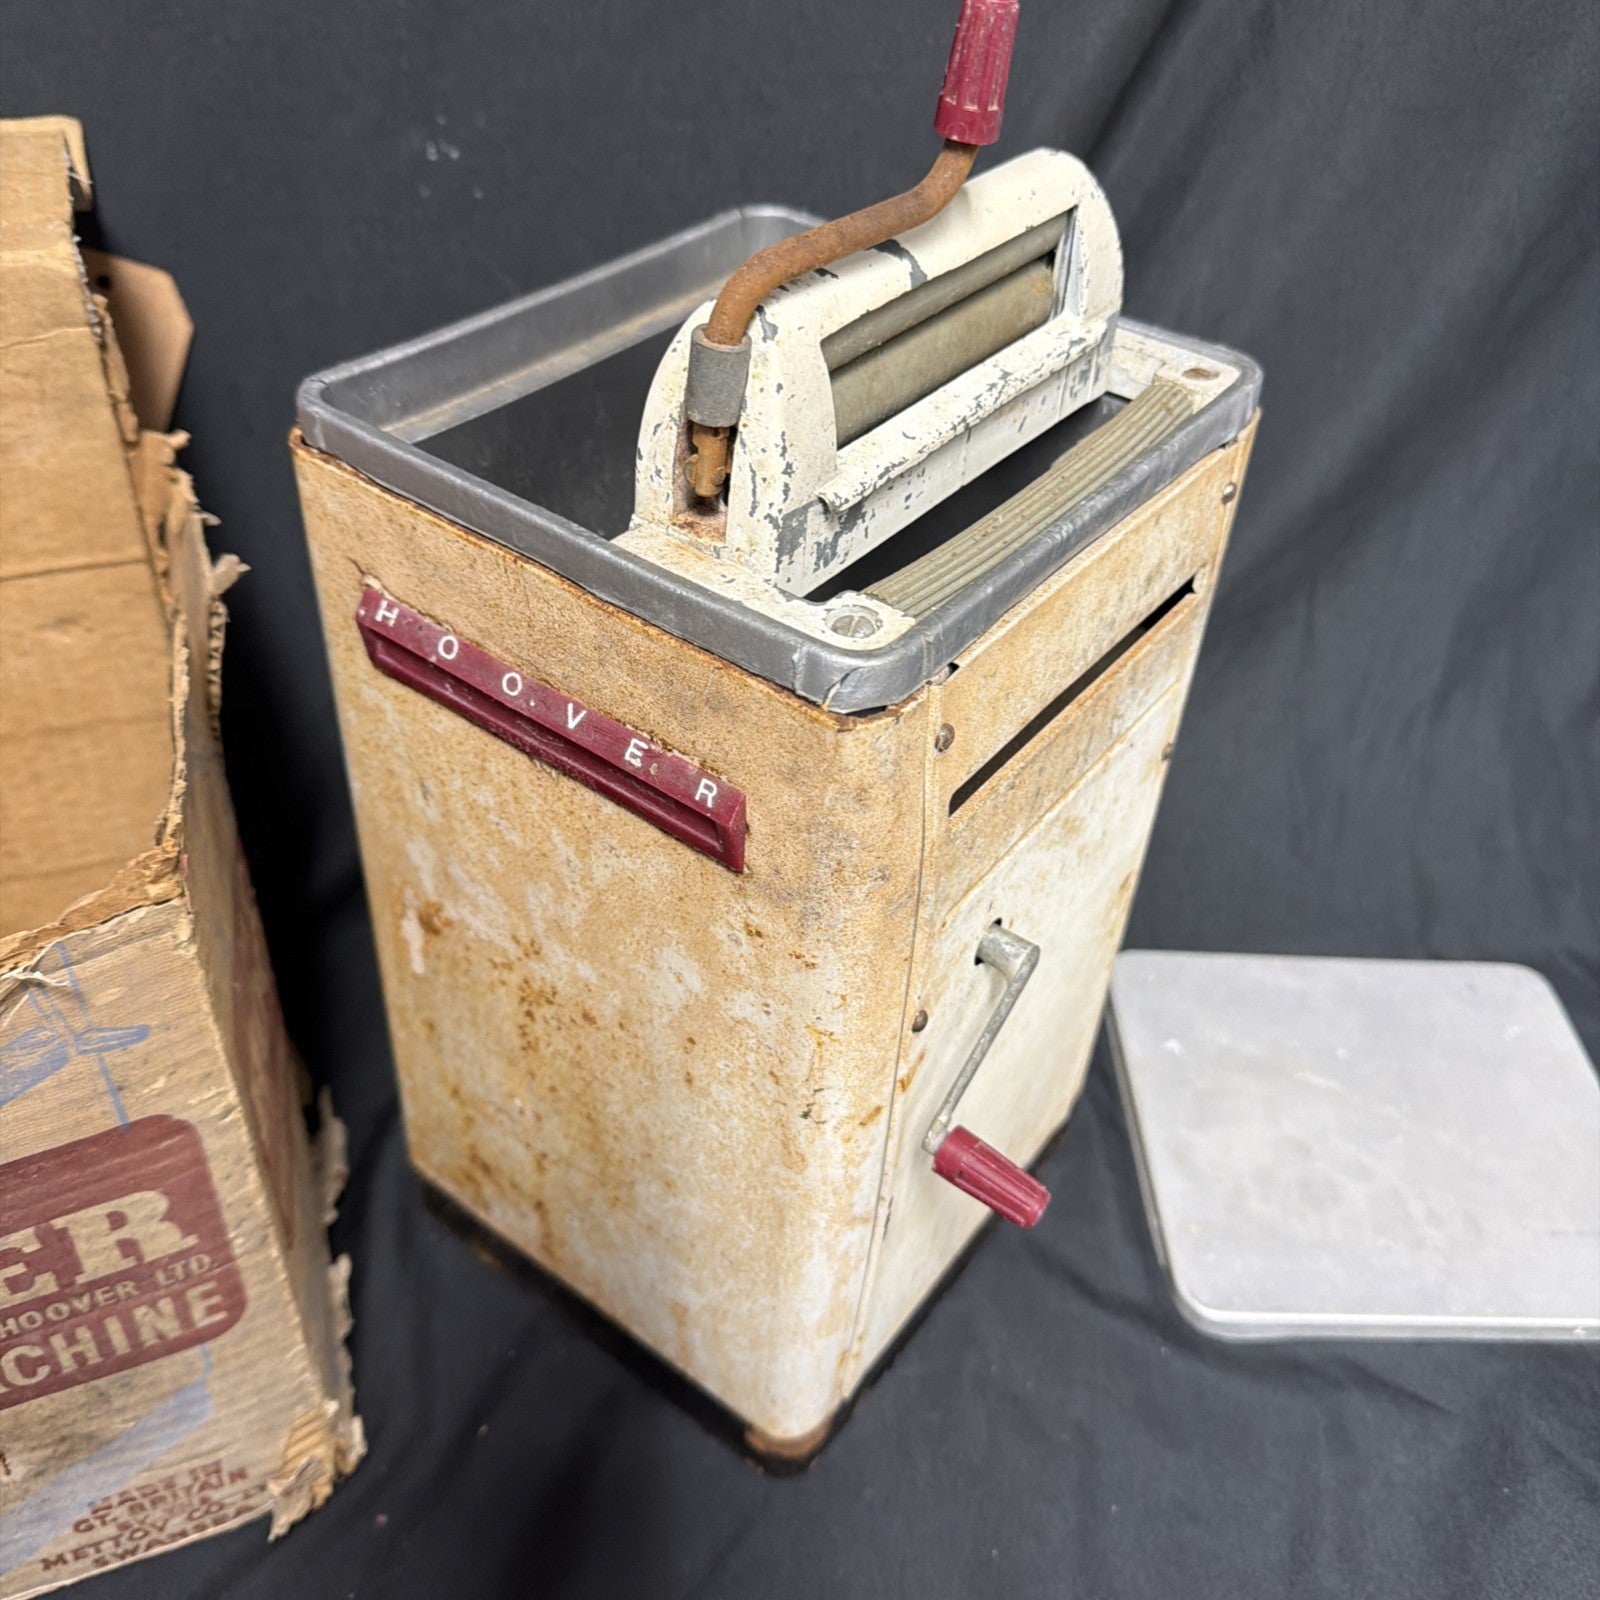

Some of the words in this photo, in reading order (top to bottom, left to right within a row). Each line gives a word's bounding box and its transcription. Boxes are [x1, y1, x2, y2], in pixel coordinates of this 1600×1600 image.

[375, 601, 718, 807] HOOVER
[0, 1281, 140, 1339] HOOVER
[0, 1281, 228, 1392] CHINE
